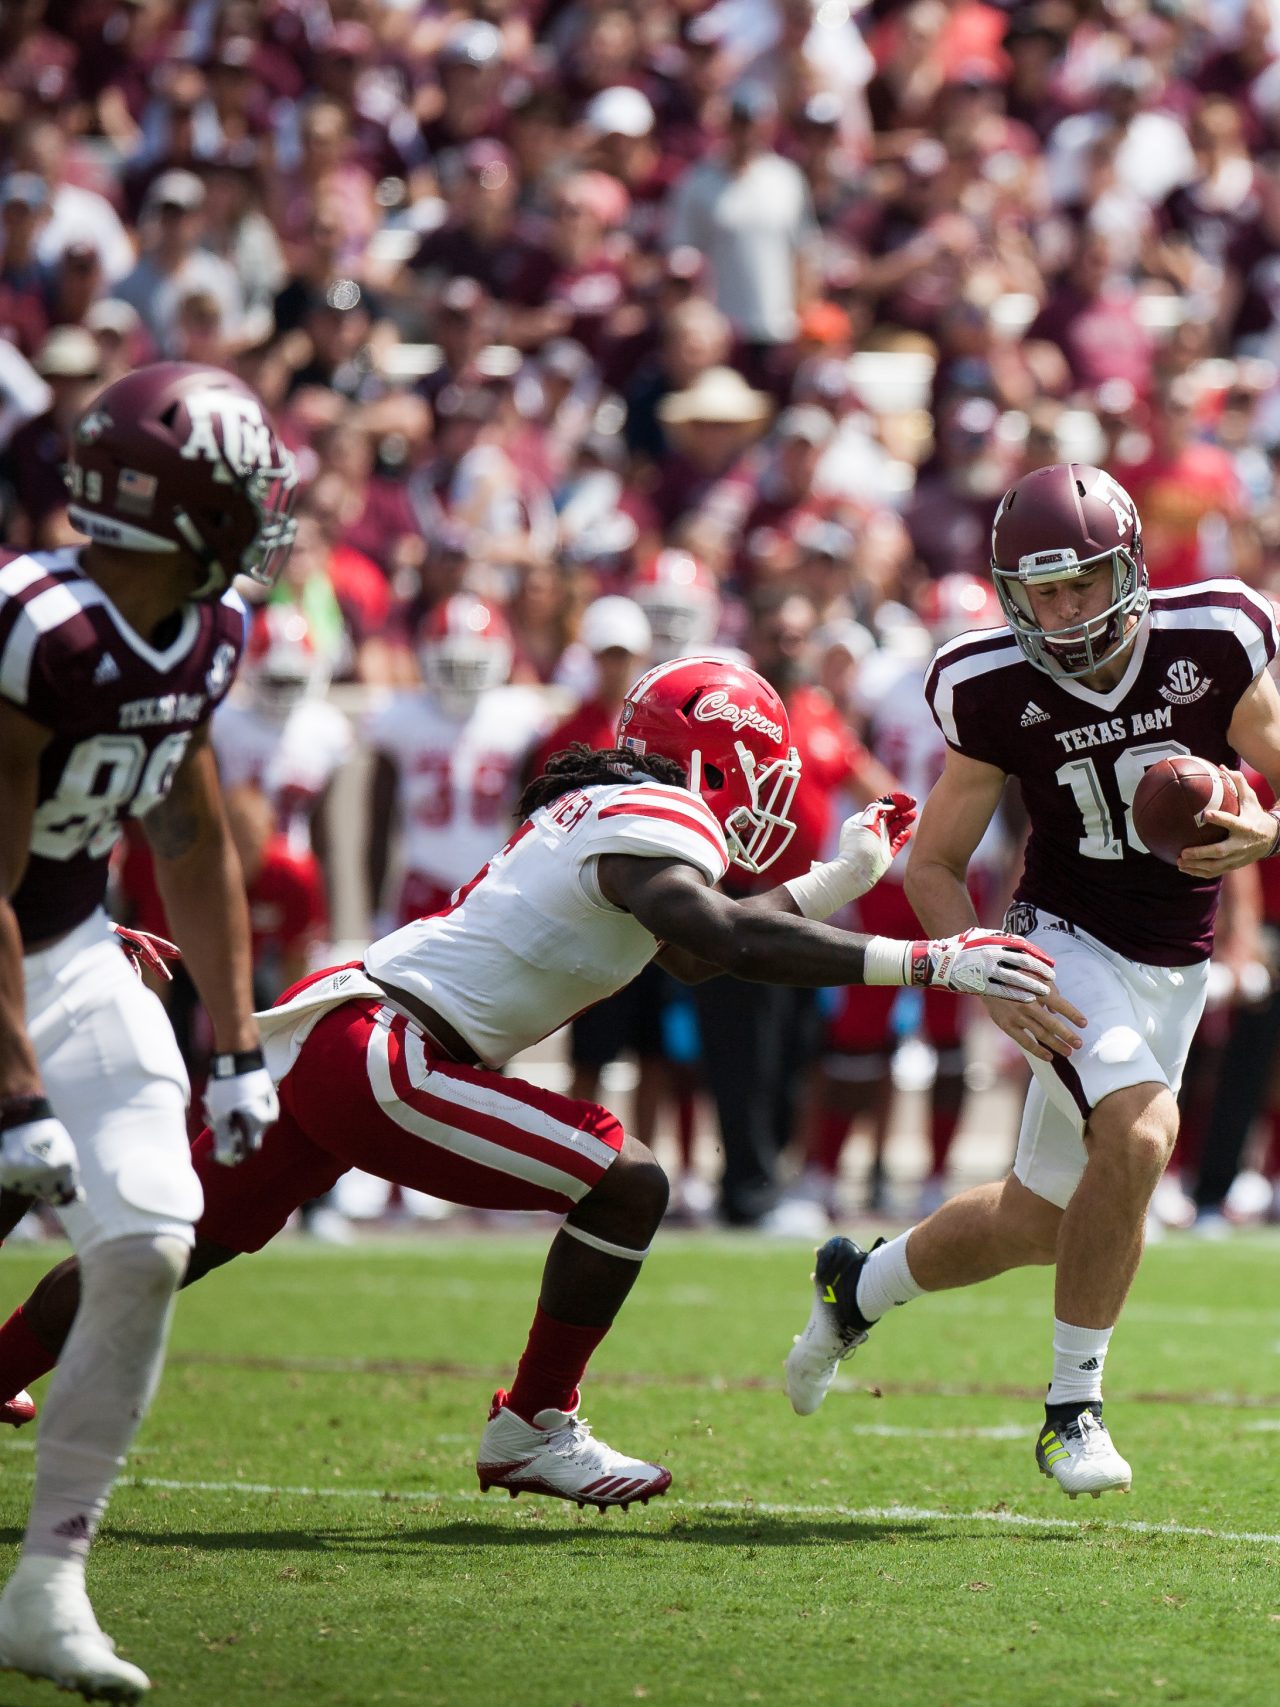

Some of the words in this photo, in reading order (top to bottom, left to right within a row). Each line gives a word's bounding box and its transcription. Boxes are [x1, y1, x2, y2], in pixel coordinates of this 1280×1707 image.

[1166, 660, 1199, 692] SEC
[1165, 685, 1206, 704] GRADUATE
[694, 691, 782, 744] Cajuns
[1020, 712, 1051, 728] adidas
[1055, 718, 1127, 753] TEXAS
[1132, 705, 1173, 737] A&M
